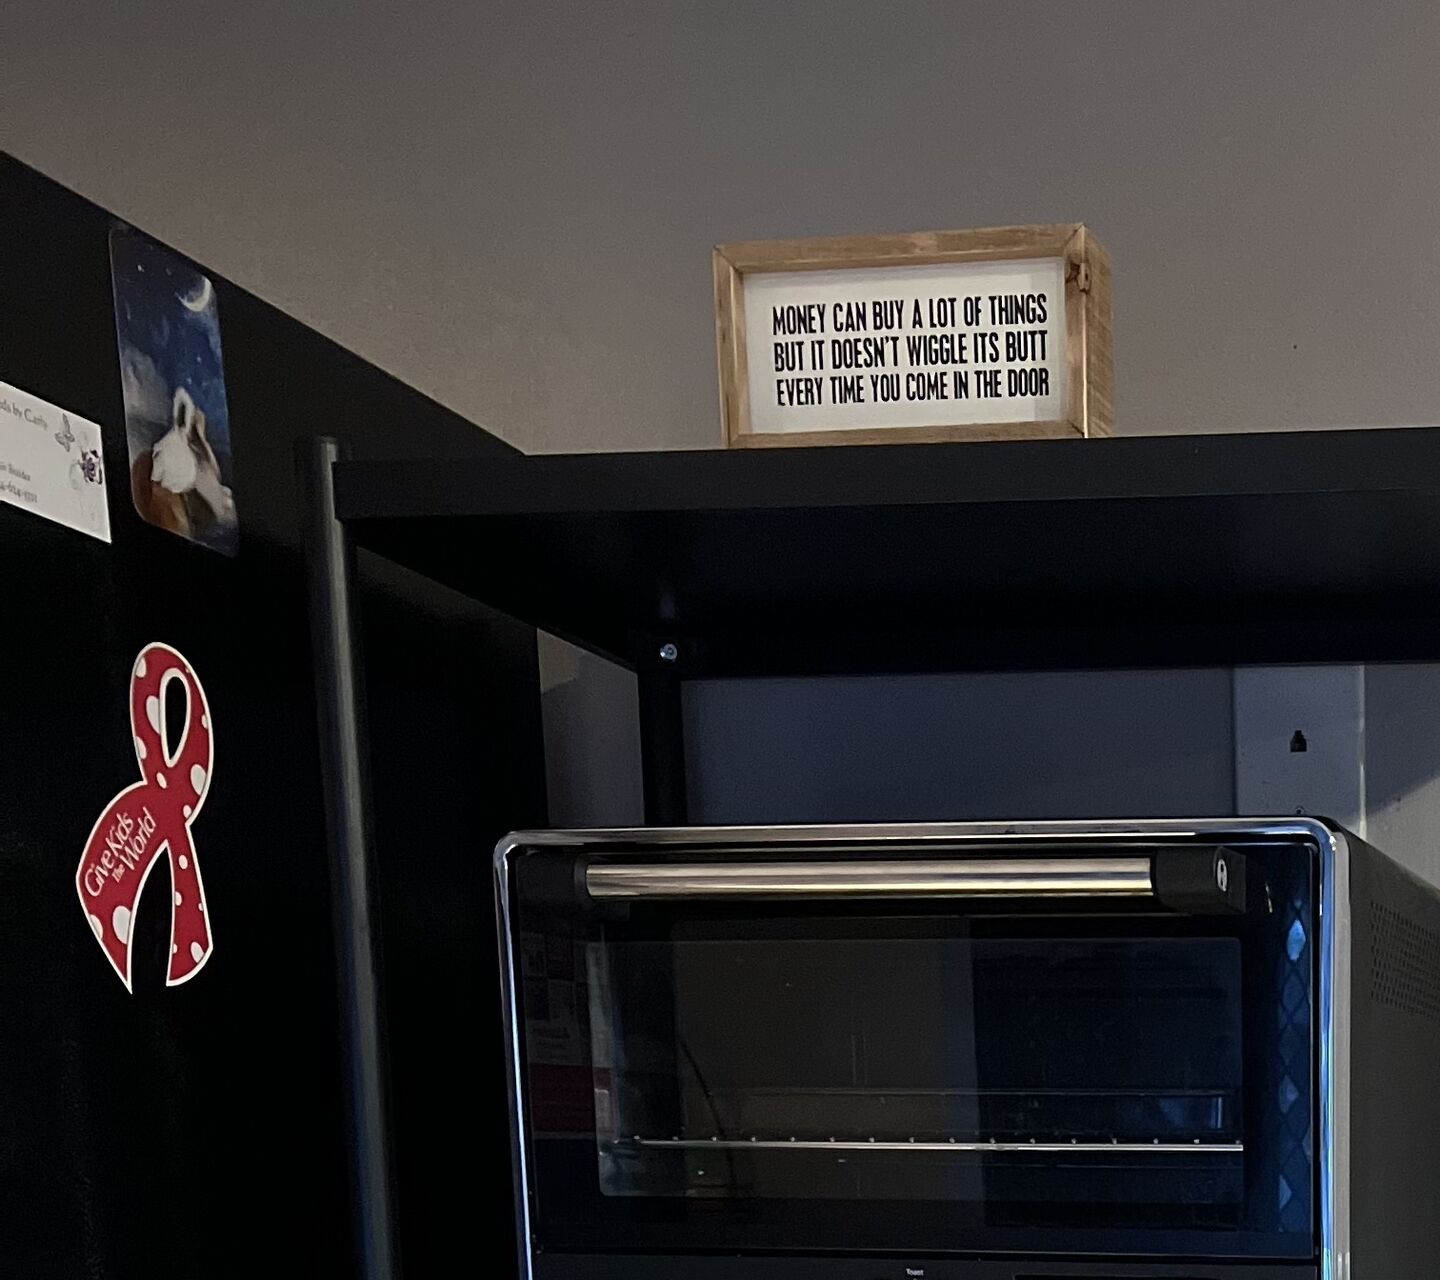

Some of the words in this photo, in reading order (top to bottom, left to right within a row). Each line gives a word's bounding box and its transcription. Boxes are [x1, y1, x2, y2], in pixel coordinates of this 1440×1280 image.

[772, 303, 826, 336] MONEY
[833, 301, 867, 332] CAN
[872, 299, 904, 331] BUY
[912, 298, 924, 329] A
[929, 297, 957, 327] LOT
[964, 296, 983, 326] OF
[988, 293, 1048, 325] THINGS
[774, 340, 804, 372] BUT
[811, 339, 825, 370] IT
[832, 336, 900, 369] DOESN'T
[906, 333, 968, 366] WIGGLE
[973, 331, 1000, 363] ITS
[1005, 329, 1049, 362] BUTT
[776, 376, 823, 406] EVERY
[829, 374, 865, 404] TIME
[871, 373, 900, 402] YOU
[906, 371, 948, 401] COME
[953, 370, 969, 399] IN
[974, 369, 1002, 398] THE
[1007, 367, 1050, 397] DOOR
[85, 847, 115, 897] Give
[106, 812, 134, 857] Kids
[121, 806, 157, 871] World
